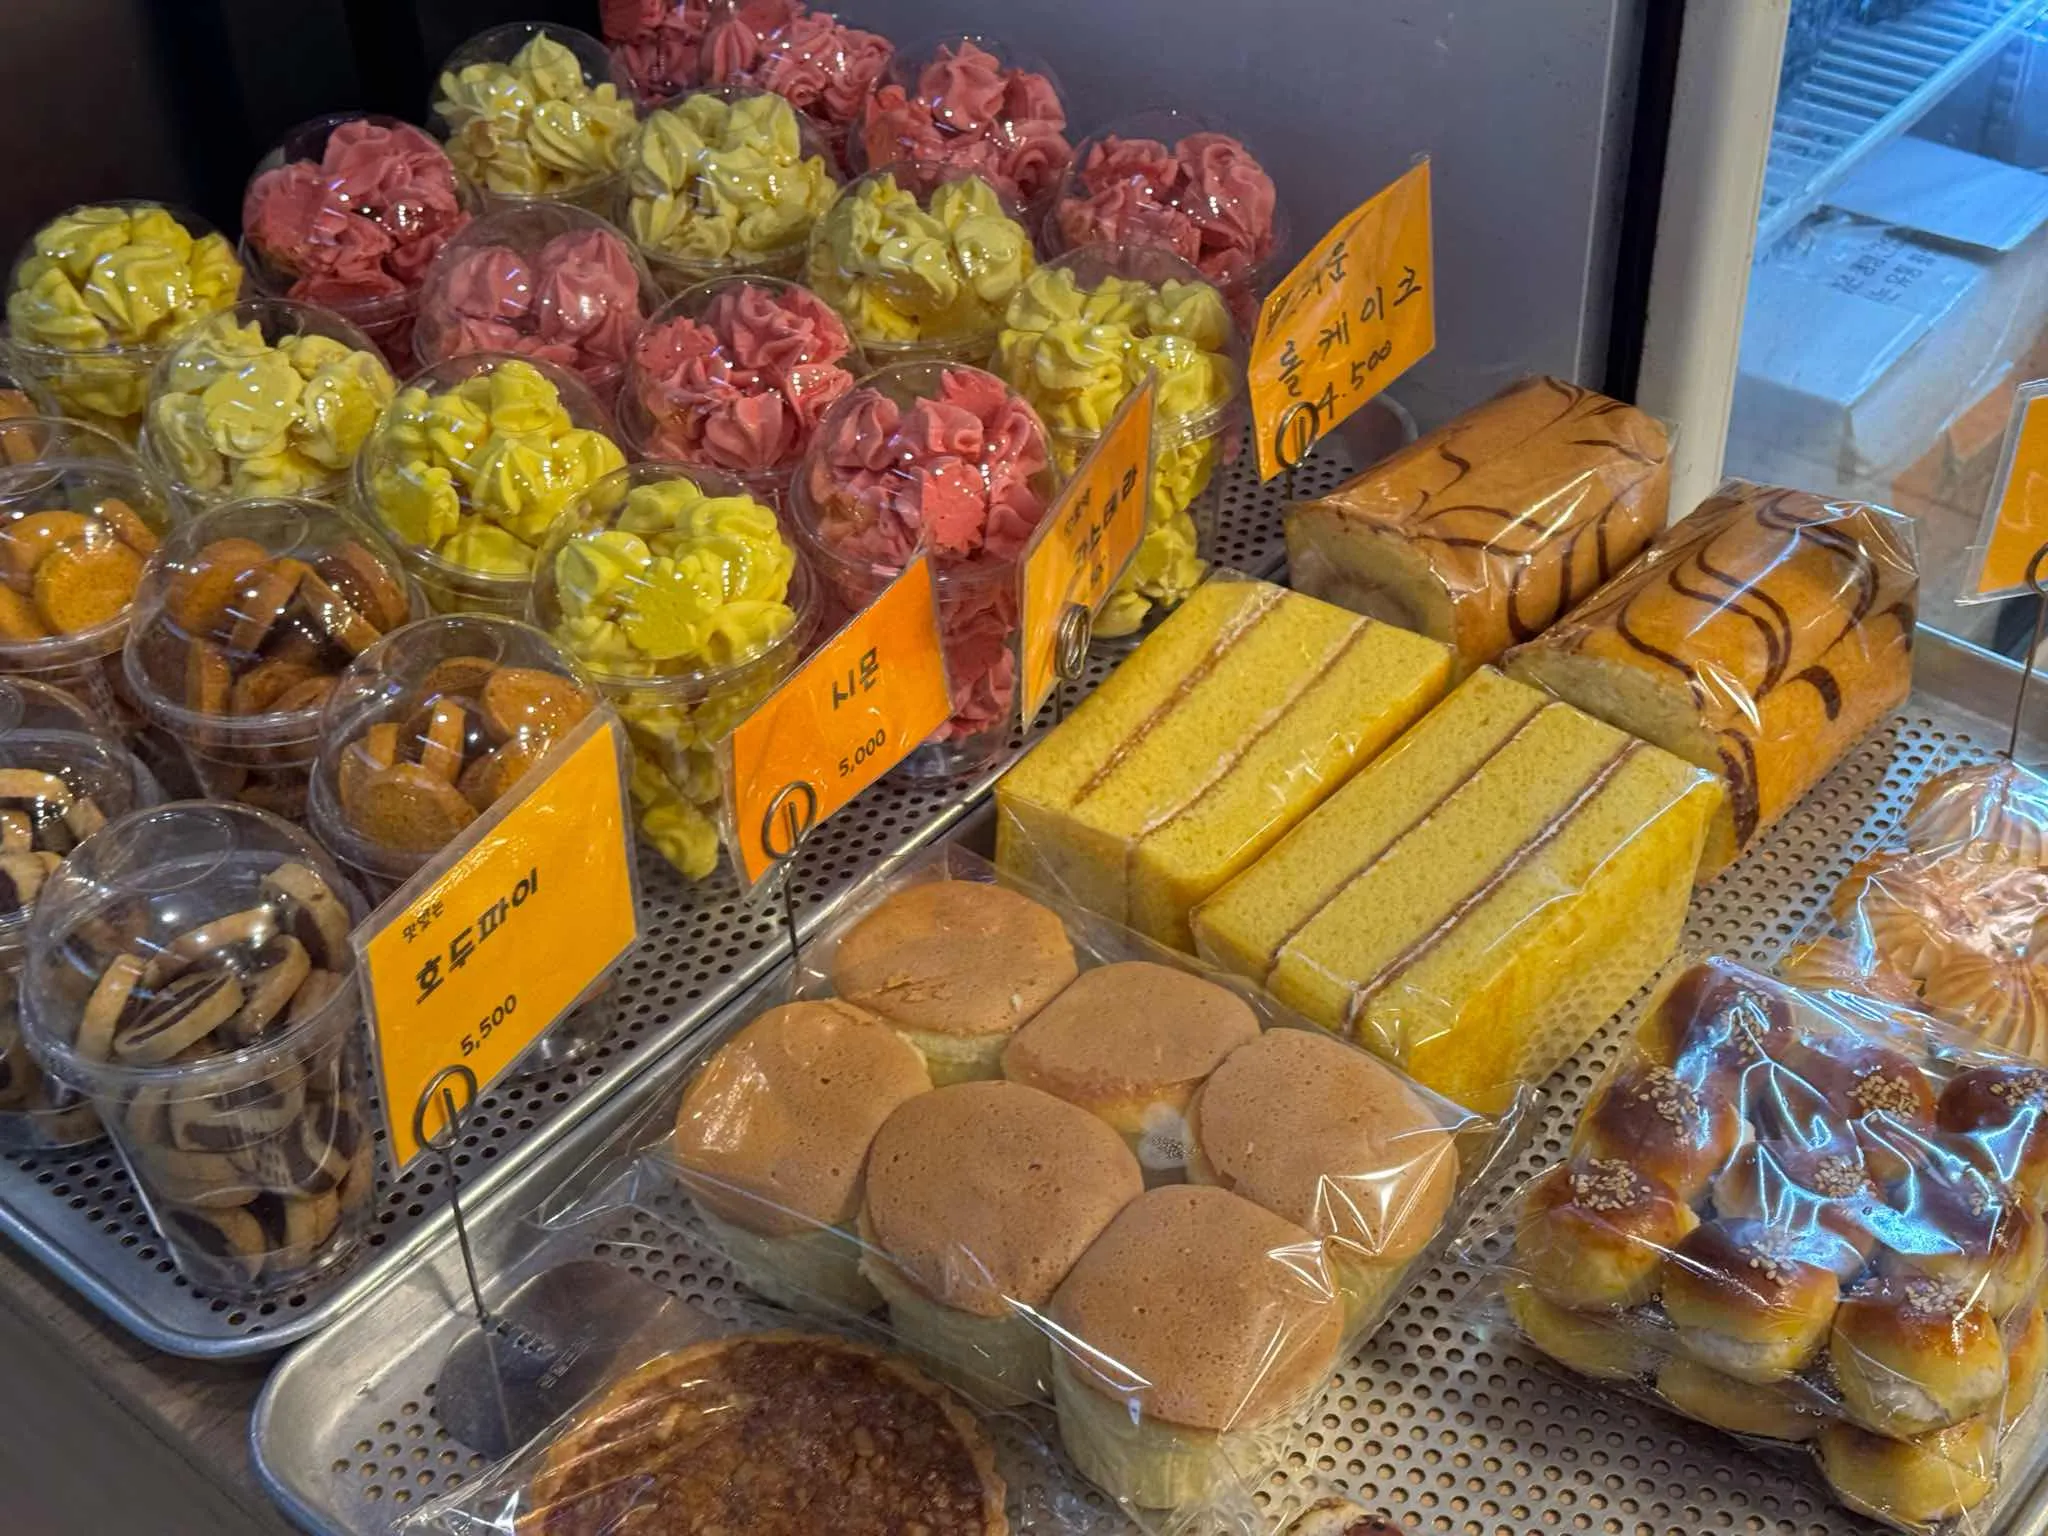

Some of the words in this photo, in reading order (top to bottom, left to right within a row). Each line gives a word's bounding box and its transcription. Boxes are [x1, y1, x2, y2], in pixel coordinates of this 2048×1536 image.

[839, 728, 886, 778] 5,000
[416, 868, 538, 1005] 호두파이
[460, 994, 517, 1057] 5,500
